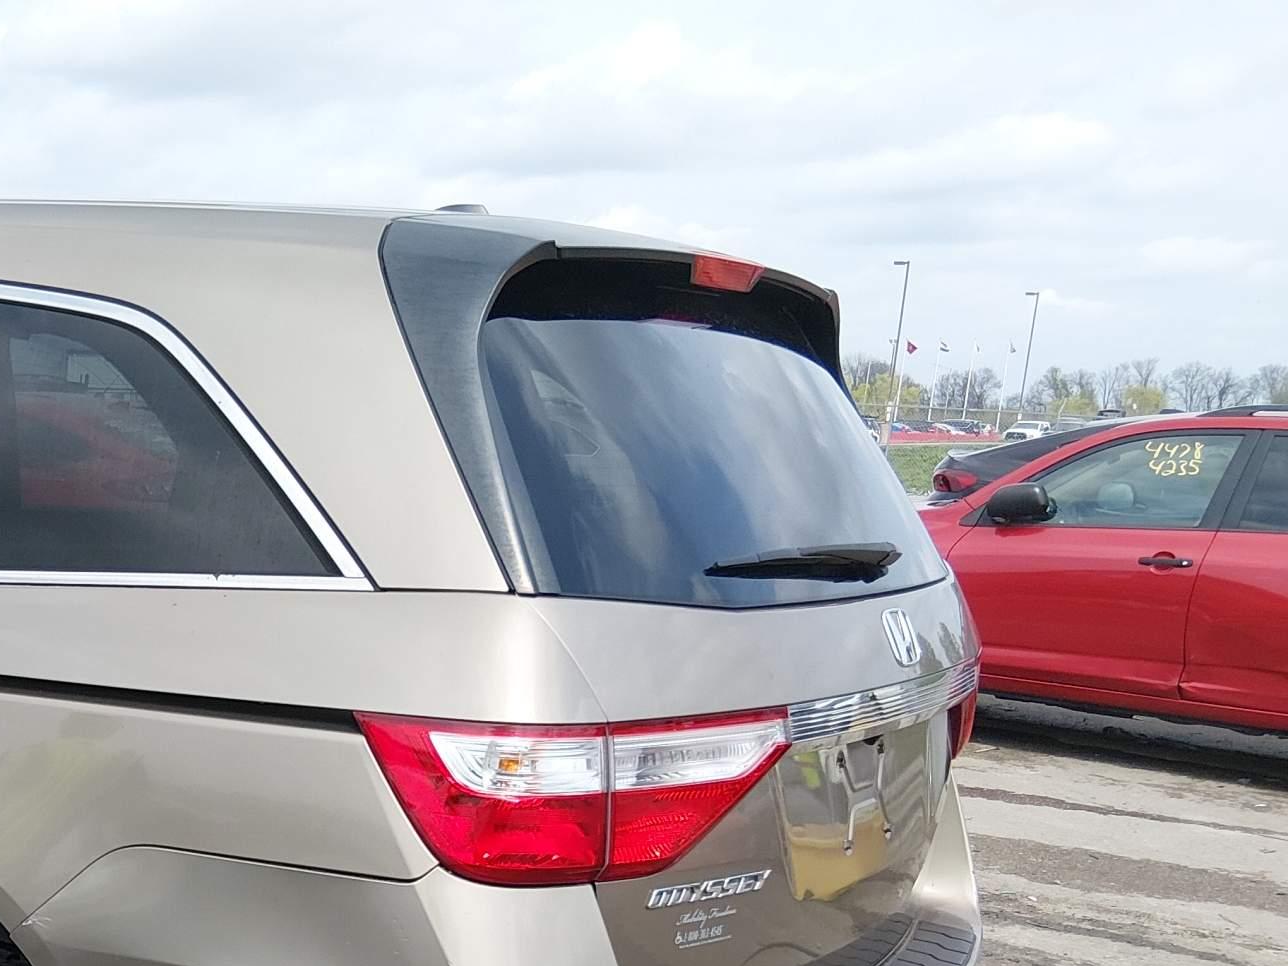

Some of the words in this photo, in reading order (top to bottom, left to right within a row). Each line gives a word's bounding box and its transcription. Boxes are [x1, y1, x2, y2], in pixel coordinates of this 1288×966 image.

[1145, 441, 1205, 460] 4478
[1149, 459, 1203, 476] 4235
[646, 869, 772, 908] ODYSSEY
